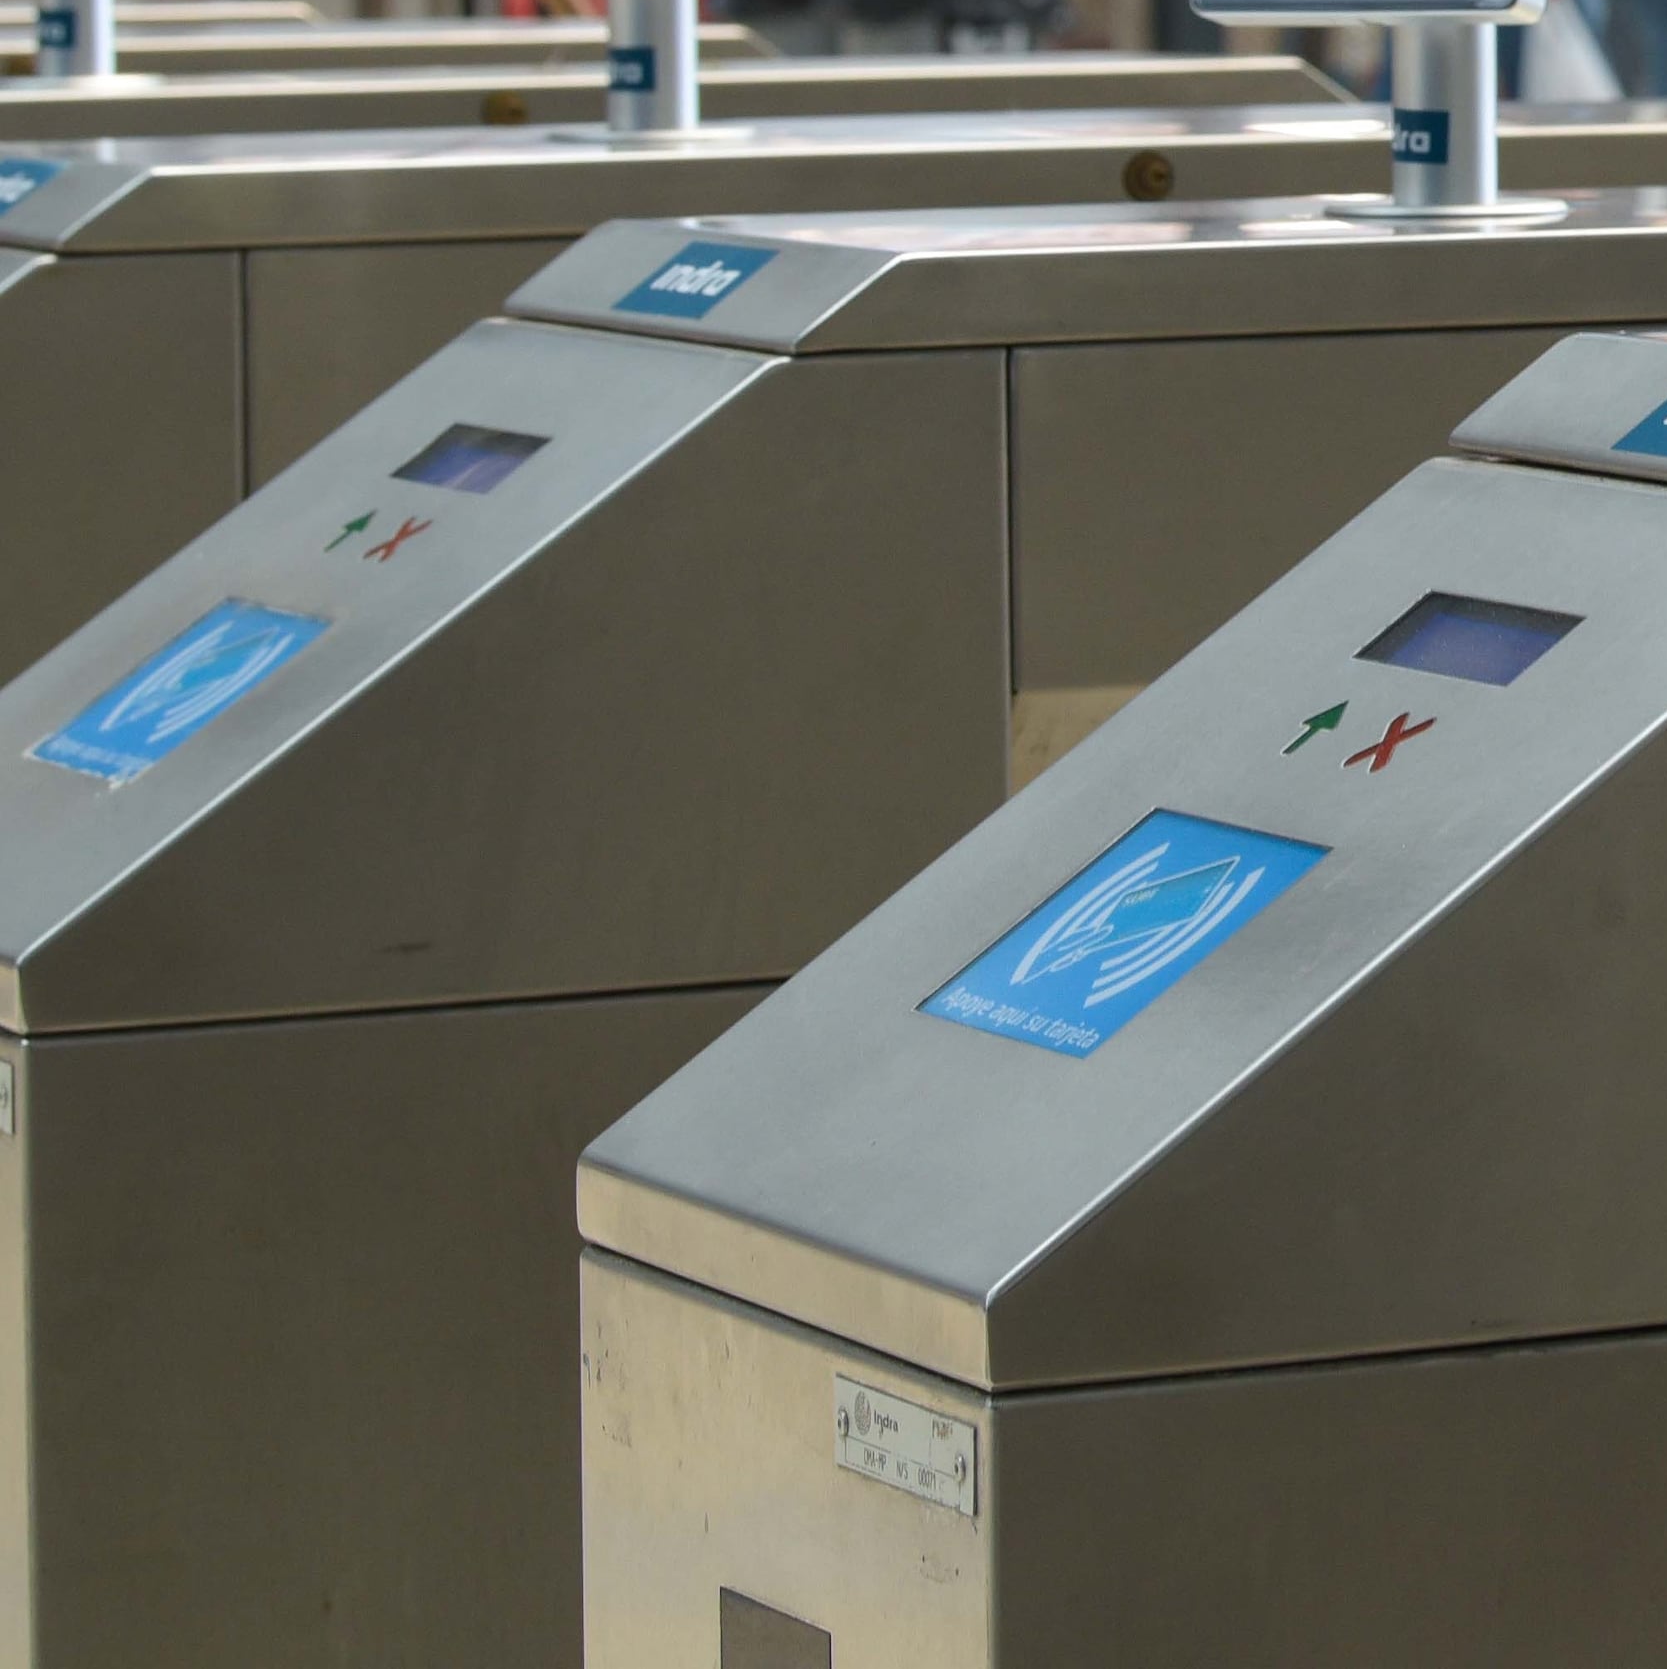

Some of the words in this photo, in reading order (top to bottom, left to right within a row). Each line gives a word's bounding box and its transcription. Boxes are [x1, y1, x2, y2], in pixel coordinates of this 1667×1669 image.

[1022, 1014, 1049, 1033] su
[1044, 1018, 1099, 1049] tarjeta
[874, 1410, 899, 1433] Indra
